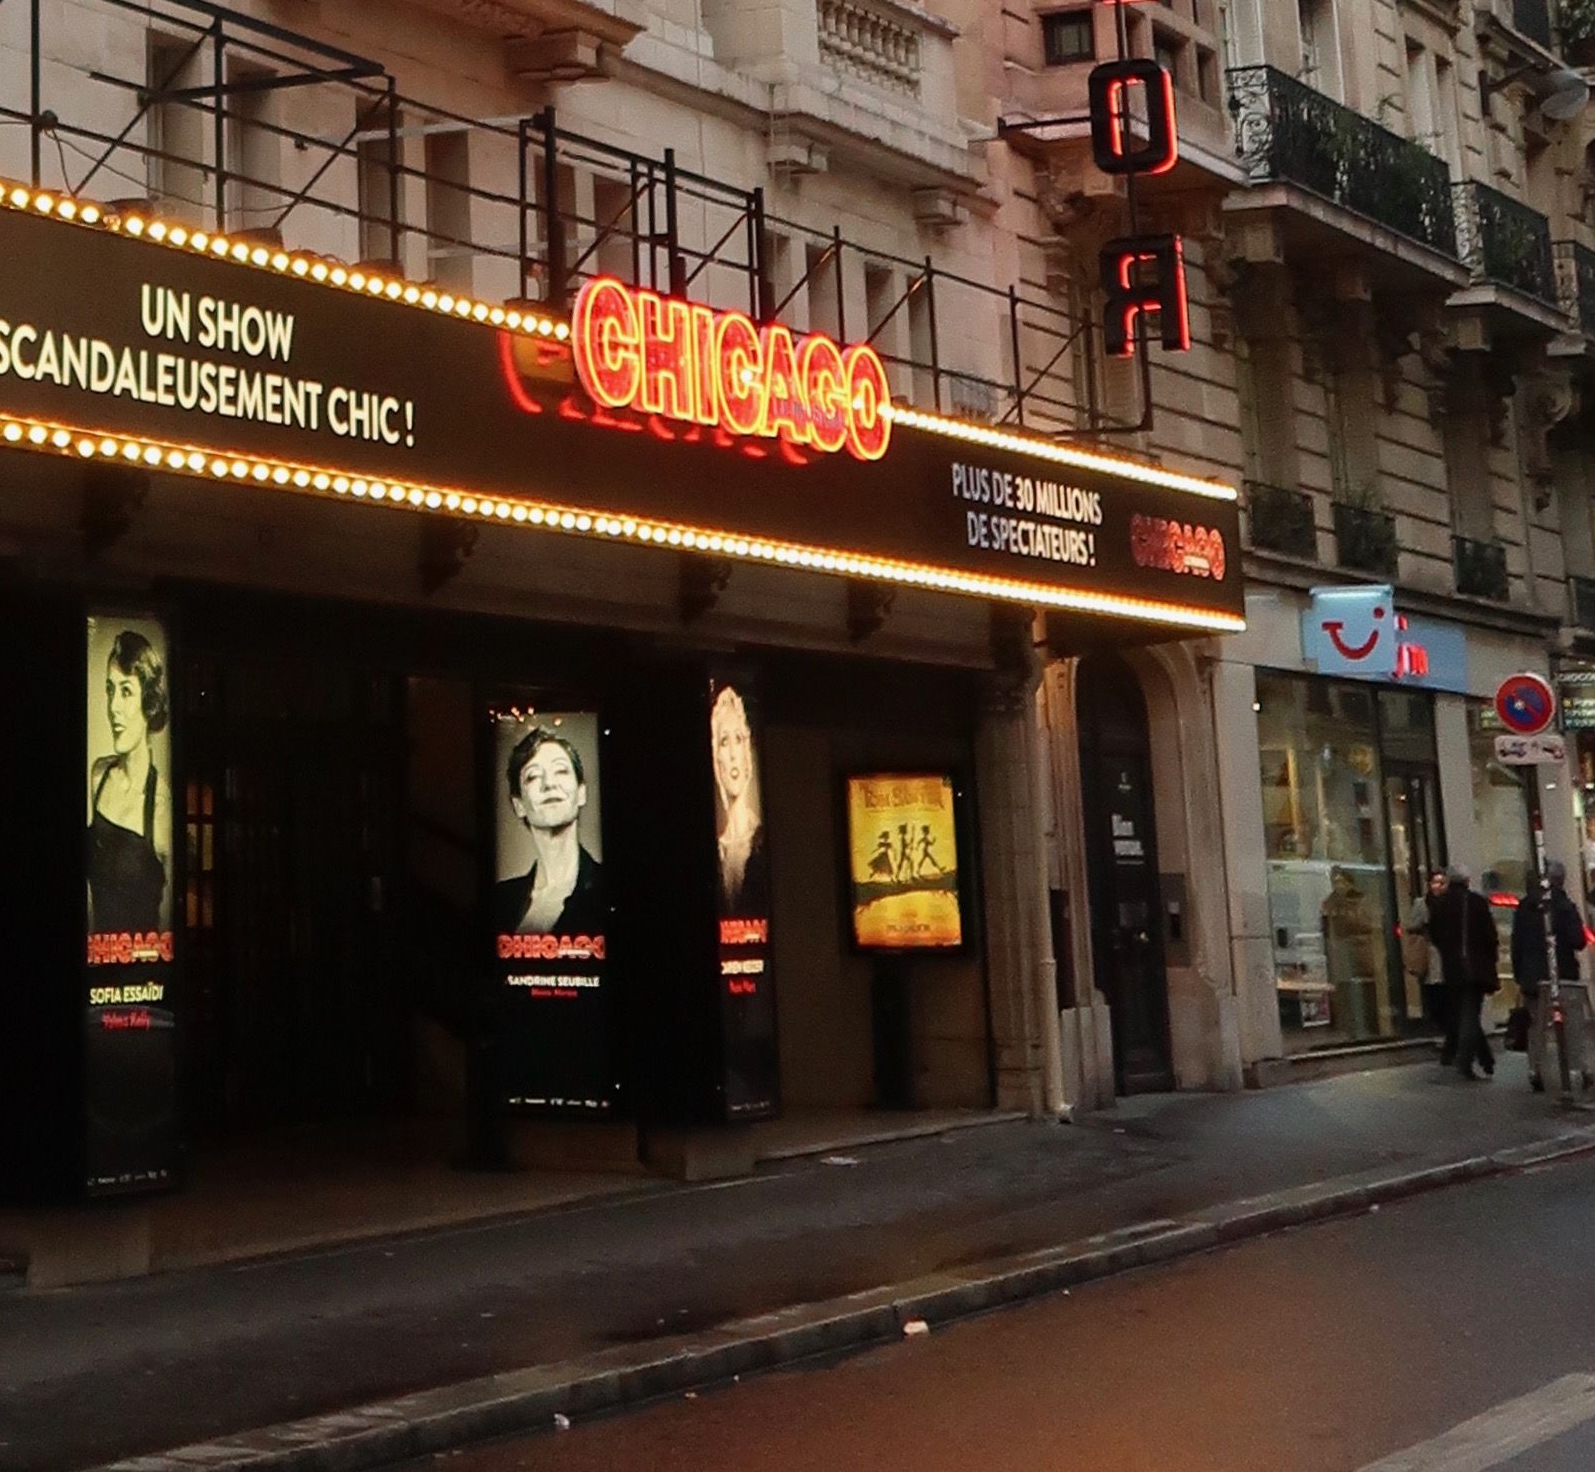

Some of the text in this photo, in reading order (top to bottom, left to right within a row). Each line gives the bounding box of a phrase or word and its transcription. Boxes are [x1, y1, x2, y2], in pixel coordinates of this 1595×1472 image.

[141, 284, 295, 363] UN SHOW
[572, 277, 892, 461] CHICAGO
[951, 462, 1103, 526] PLUS DE 30 MILLIONS
[966, 511, 988, 549] DE
[1130, 512, 1226, 581] CHICAGO
[89, 986, 123, 1005] SOFIA
[507, 974, 557, 988] SANDRINE
